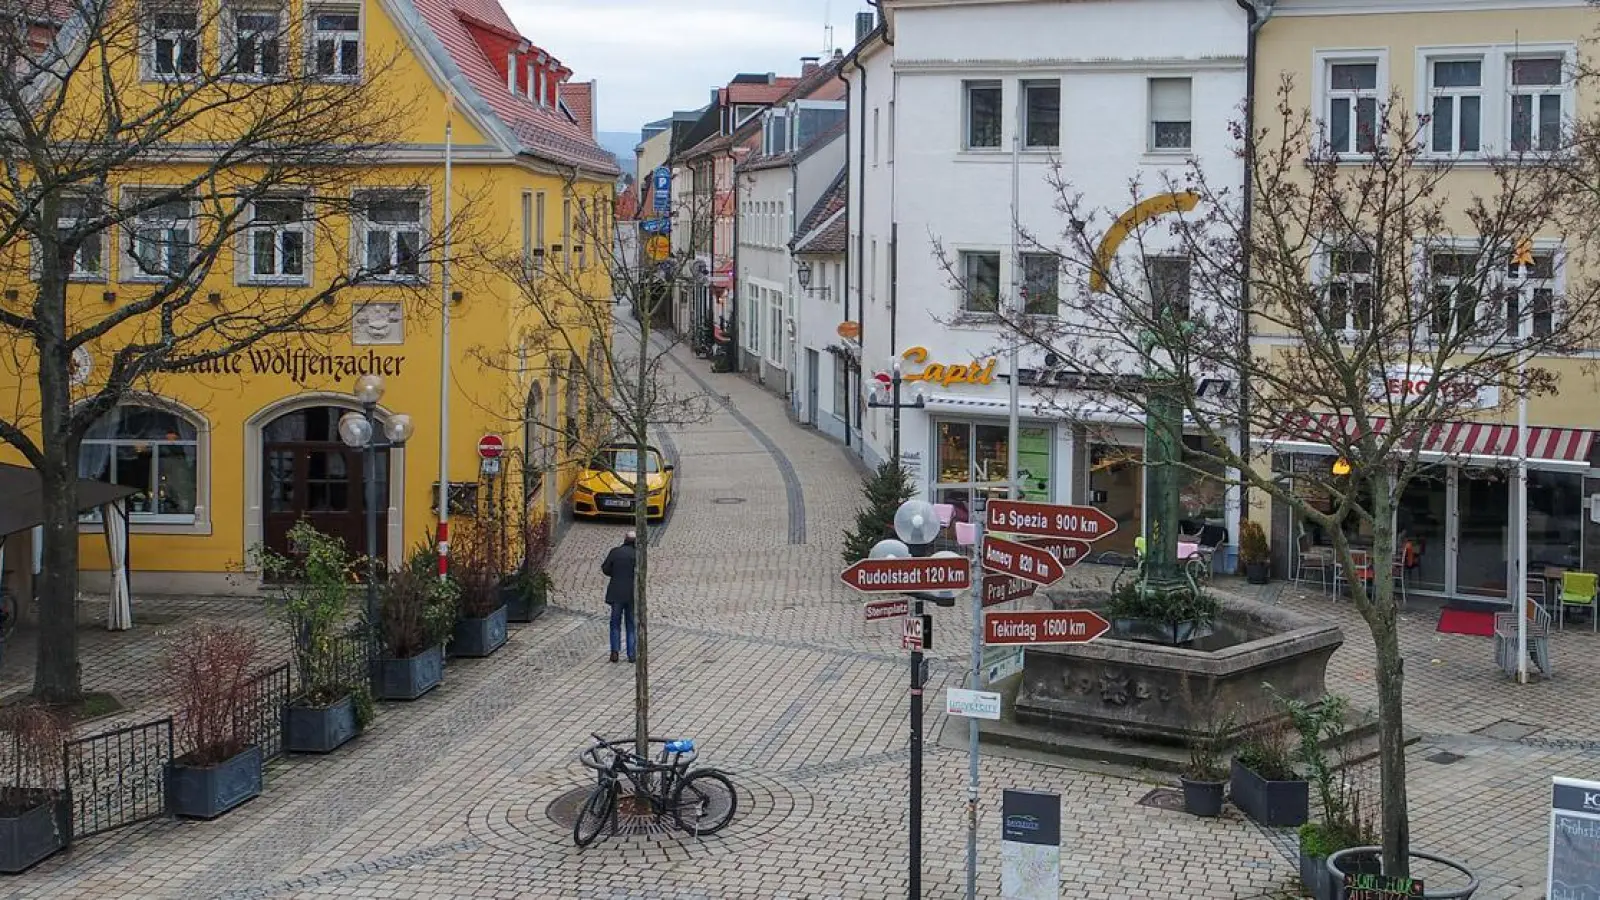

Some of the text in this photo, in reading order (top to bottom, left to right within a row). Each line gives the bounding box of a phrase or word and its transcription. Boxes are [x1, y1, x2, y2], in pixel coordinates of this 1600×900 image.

[248, 348, 406, 382] Wolffenzacher
[902, 346, 997, 387] Capri
[992, 508, 1098, 533] La Spezia 900 km
[986, 544, 1012, 570] Annecy
[1037, 559, 1049, 577] km
[1063, 544, 1077, 560] km
[858, 566, 965, 585] Rudolstadt 120 km
[988, 584, 1005, 600] Prag
[867, 602, 908, 618] Sternplatz
[905, 619, 921, 636] WC
[992, 619, 1086, 640] Tekirdag 1600 km
